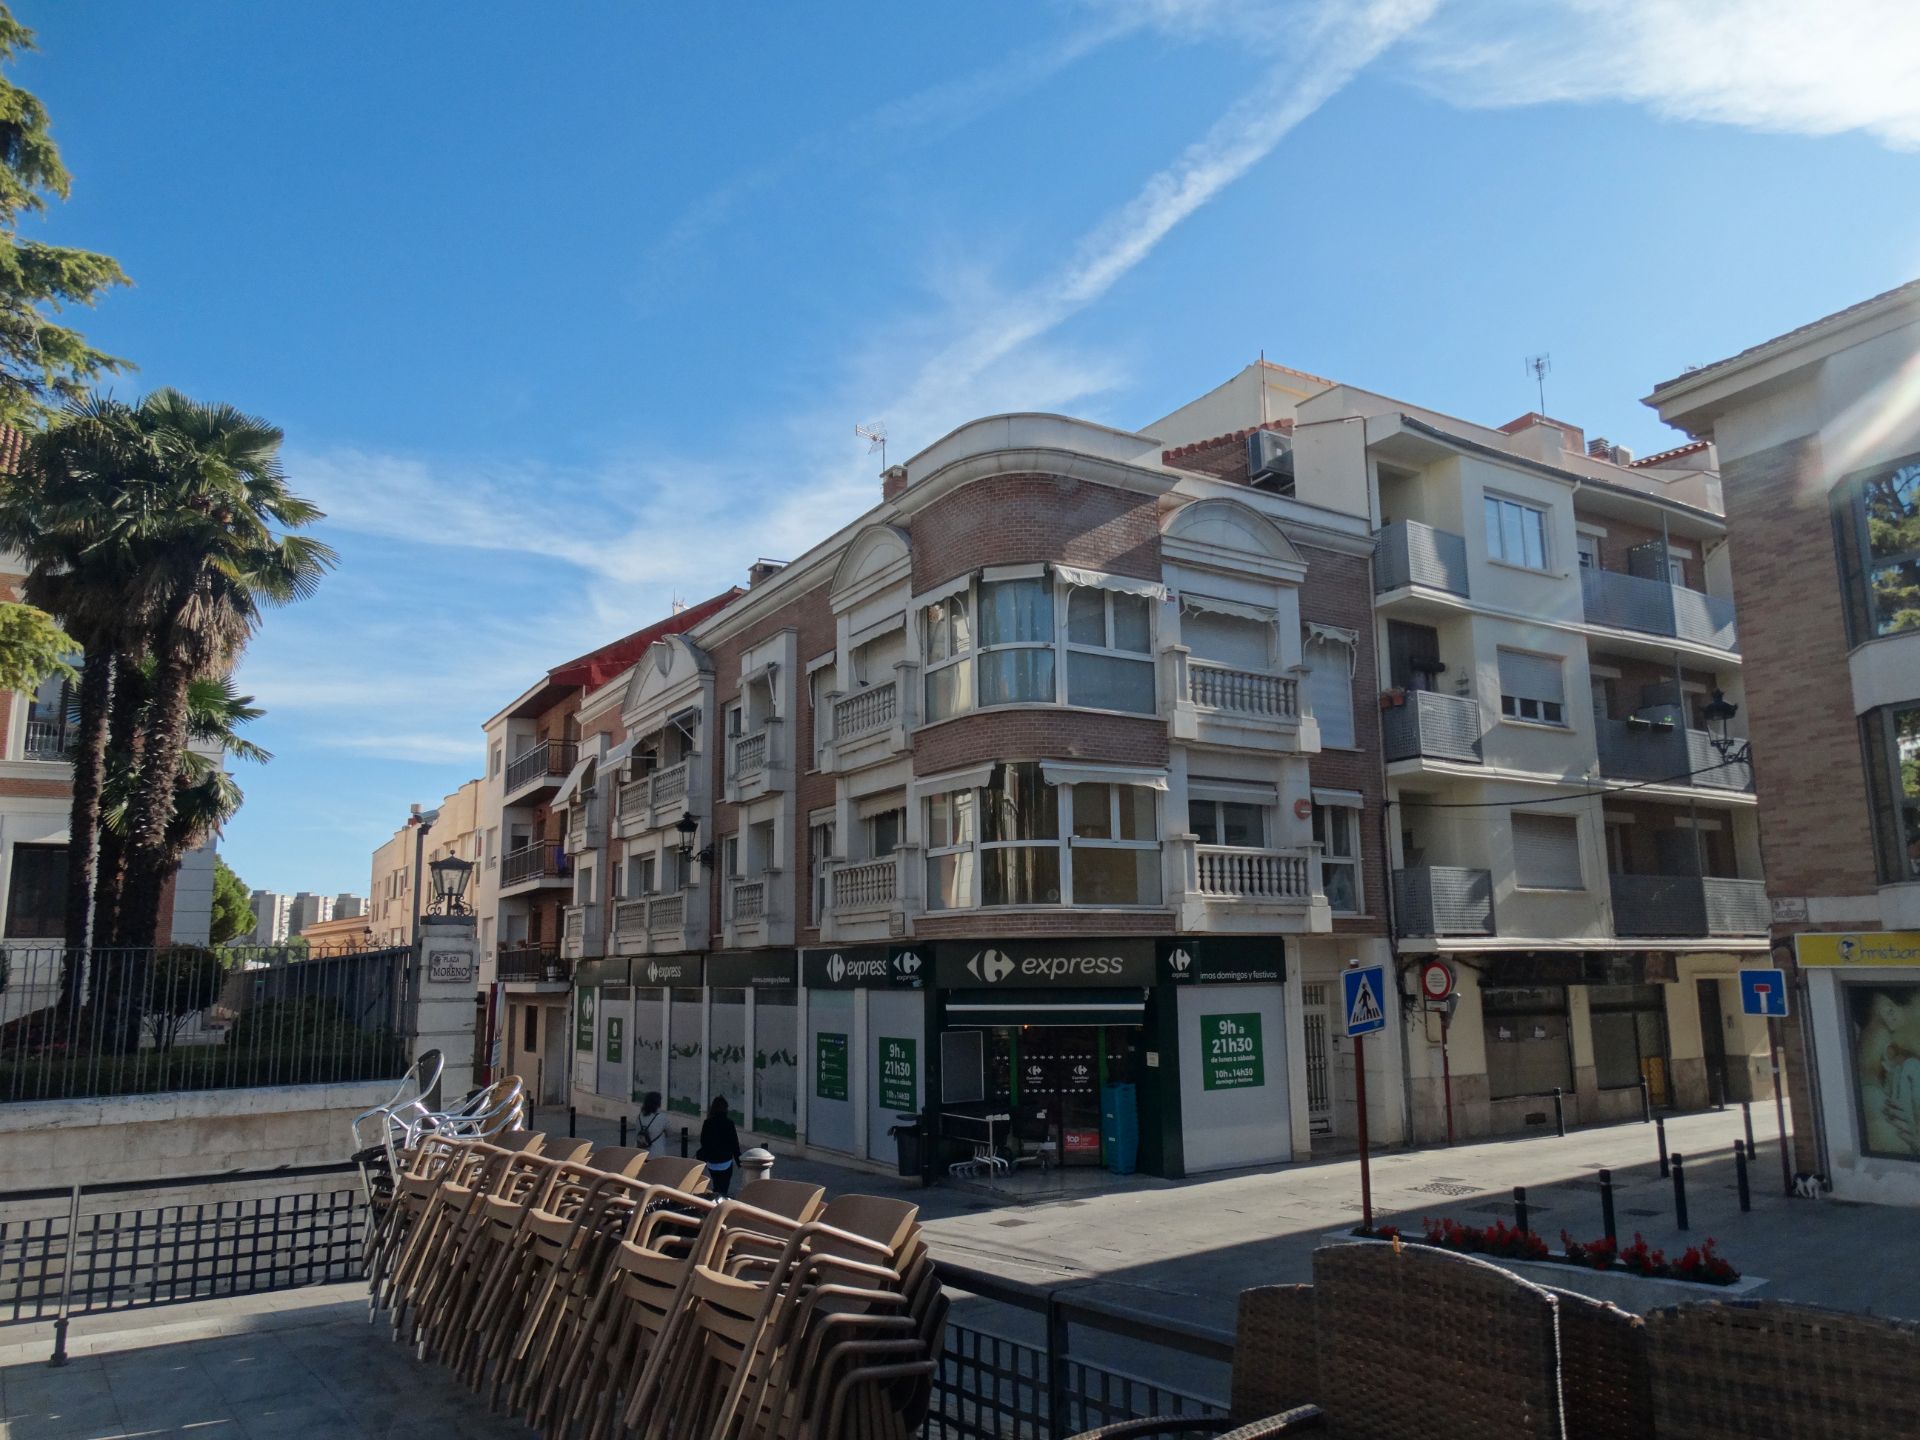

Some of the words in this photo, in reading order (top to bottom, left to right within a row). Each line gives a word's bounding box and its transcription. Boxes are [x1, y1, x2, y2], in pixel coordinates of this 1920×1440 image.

[433, 967, 467, 977] MORENO
[658, 965, 682, 981] express
[1021, 956, 1124, 980] express
[1216, 970, 1248, 980] domingos
[1253, 970, 1277, 979] festivos
[1219, 1019, 1236, 1035] 9h
[1239, 1026, 1245, 1034] a
[889, 1043, 900, 1058] 9h
[1212, 1037, 1253, 1054] 21h30
[884, 1060, 911, 1077] 21h30
[1215, 1069, 1228, 1078] 10h
[1233, 1067, 1253, 1077] 14h30
